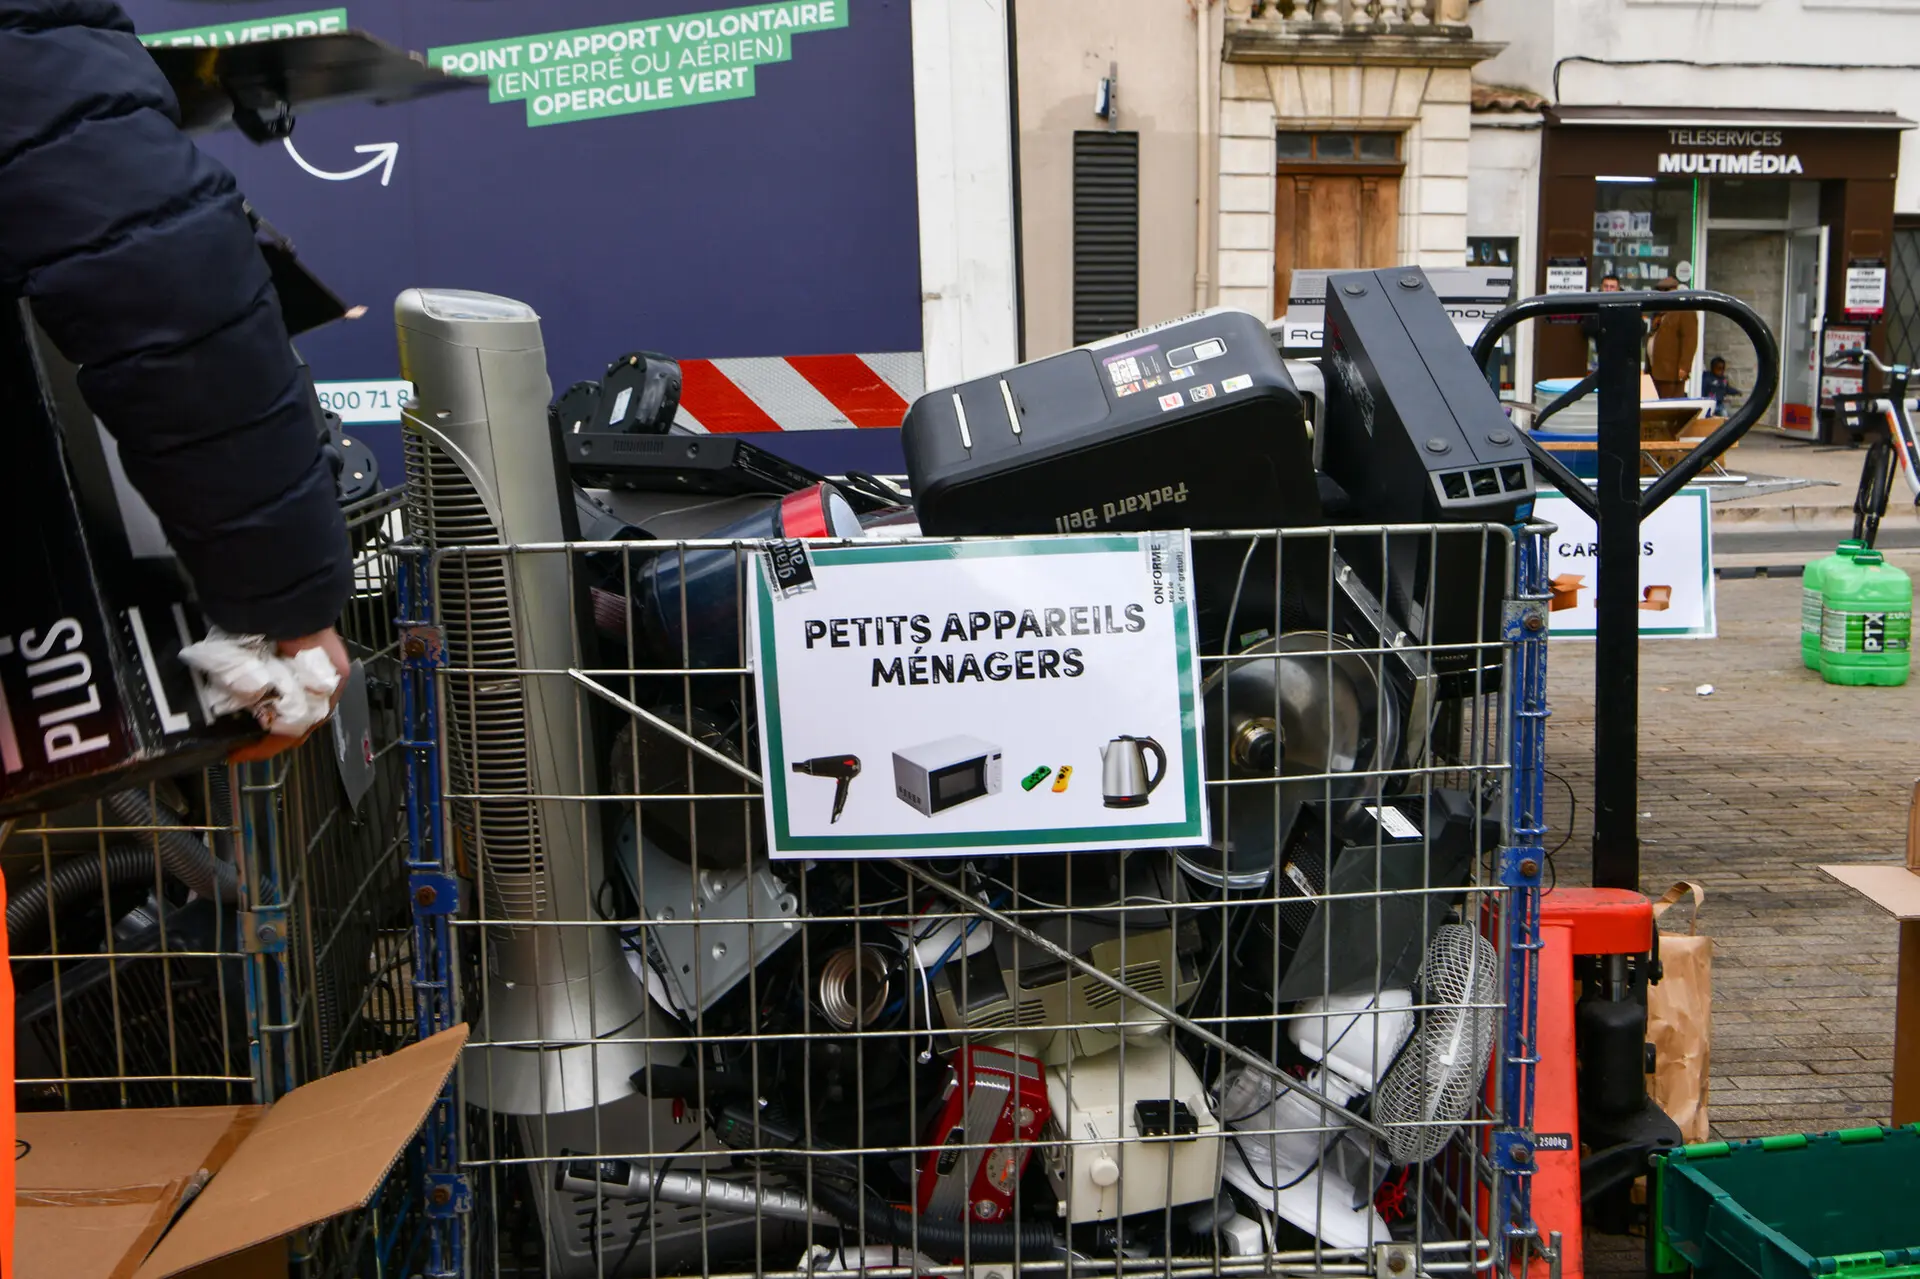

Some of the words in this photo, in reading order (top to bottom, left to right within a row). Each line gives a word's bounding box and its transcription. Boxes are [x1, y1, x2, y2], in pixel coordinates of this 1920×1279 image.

[442, 45, 523, 76] POINT
[529, 26, 662, 64] D'APPORT
[666, 1, 835, 44] VOLONTAIRE
[497, 53, 624, 97] (ENTERRÉ
[631, 51, 670, 75] OU
[678, 34, 783, 70] AÉRIEN)
[533, 78, 673, 116] OPERCULE
[679, 67, 748, 95] VERT
[1668, 129, 1782, 146] TELESERVICES
[1657, 150, 1803, 174] MULTIMÉDIA
[366, 390, 391, 408] 71
[1055, 508, 1098, 533] Bell
[1103, 482, 1189, 523] Packard
[1558, 541, 1653, 557] CARS
[1151, 543, 1164, 605] ONFORME
[804, 612, 932, 650] PETITS
[940, 602, 1147, 644] APPAREILS
[1864, 613, 1883, 651] PTX
[871, 645, 1086, 688] MÉNAGERS
[20, 617, 111, 763] PLUS
[1540, 1137, 1568, 1149] 2500kg
